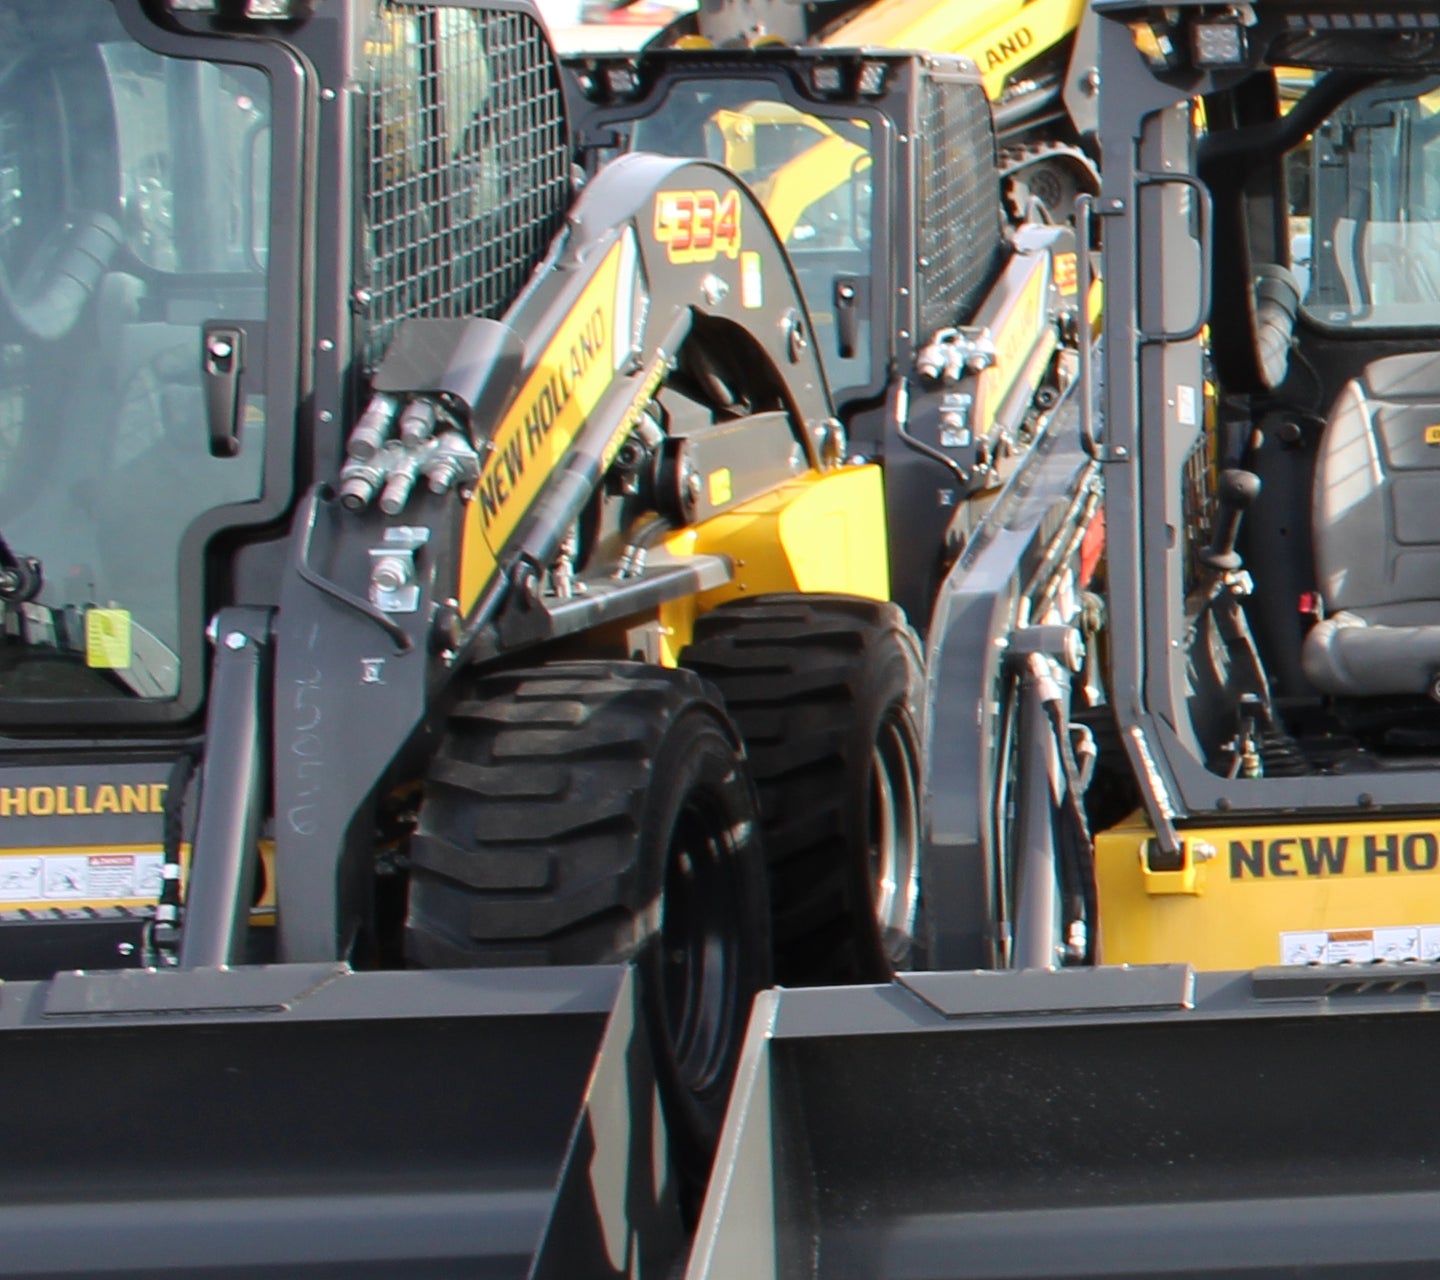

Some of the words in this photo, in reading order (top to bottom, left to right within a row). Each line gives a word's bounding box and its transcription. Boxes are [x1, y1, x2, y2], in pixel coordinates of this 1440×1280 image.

[477, 432, 528, 529] NEW
[523, 305, 607, 459] HOLLAND
[1229, 837, 1348, 879] NEW
